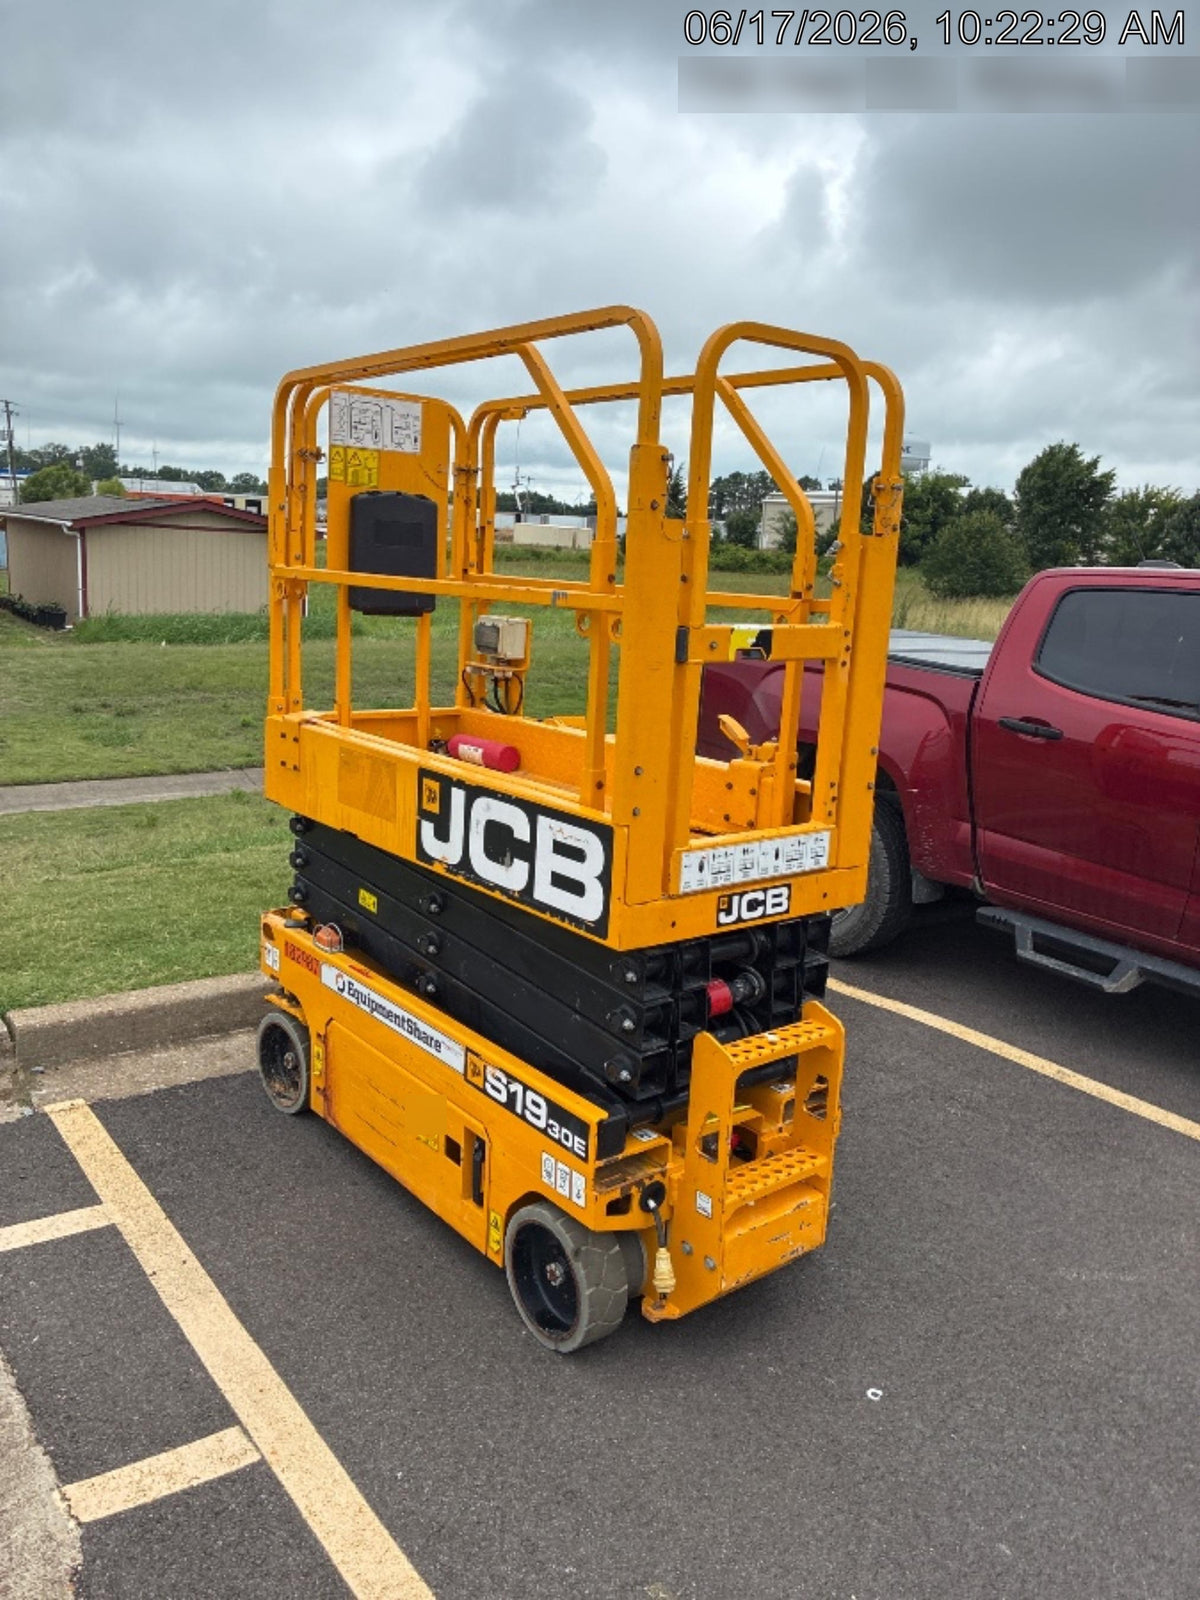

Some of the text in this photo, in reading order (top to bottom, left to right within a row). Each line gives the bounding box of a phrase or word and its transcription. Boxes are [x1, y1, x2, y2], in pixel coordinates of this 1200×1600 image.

[420, 787, 605, 922] JCB
[719, 887, 791, 923] JCB
[347, 981, 442, 1053] EquipmentShare
[485, 1065, 586, 1157] S19 30E
